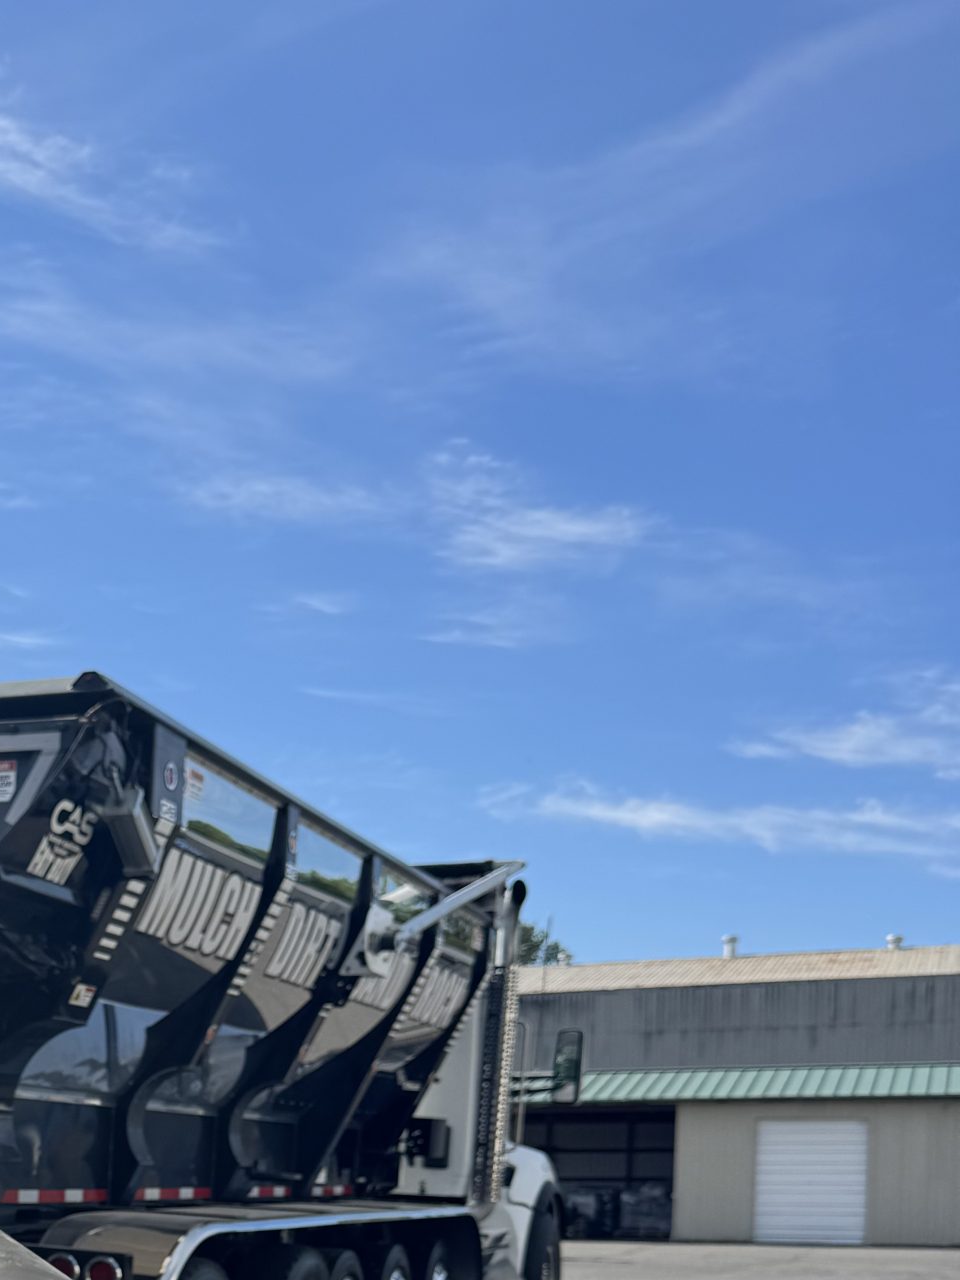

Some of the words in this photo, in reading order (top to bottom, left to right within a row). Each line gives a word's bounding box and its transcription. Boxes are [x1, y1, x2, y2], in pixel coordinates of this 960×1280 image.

[50, 799, 99, 846] CAS
[136, 847, 262, 961] MULCH
[263, 902, 341, 989] DIRT
